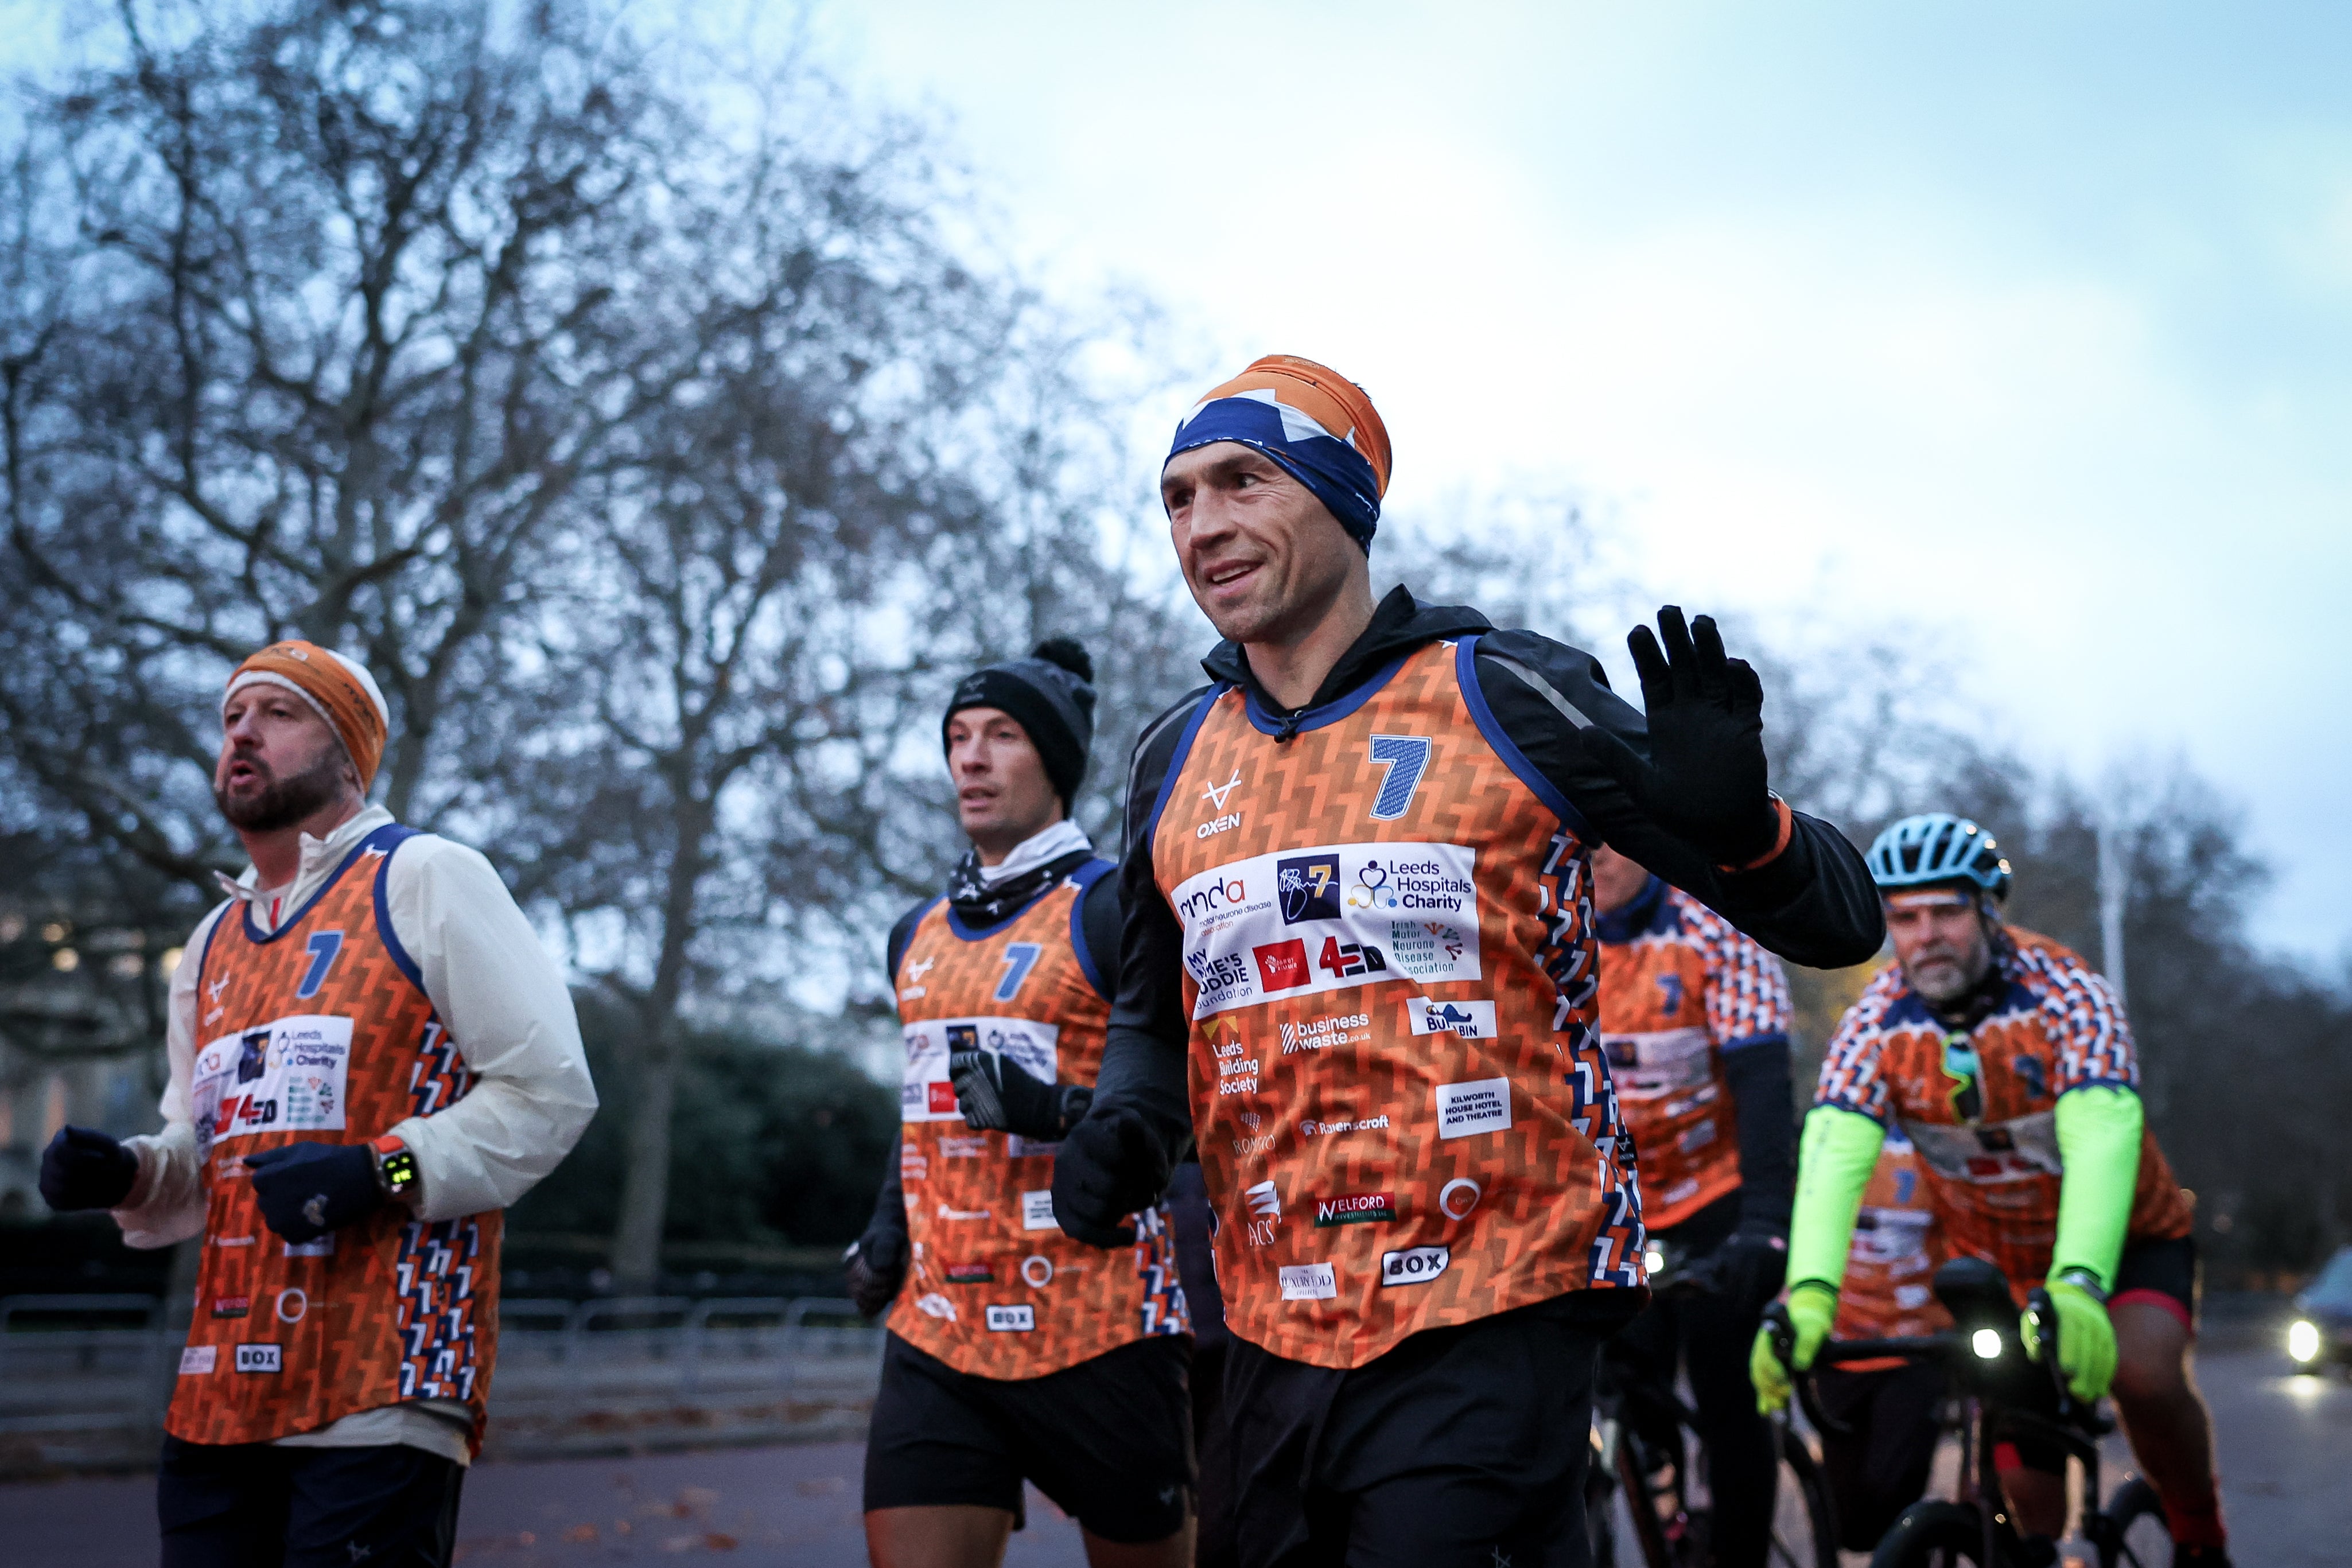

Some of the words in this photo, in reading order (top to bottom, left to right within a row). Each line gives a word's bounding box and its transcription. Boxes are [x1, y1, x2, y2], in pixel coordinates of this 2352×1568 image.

[1369, 734, 1432, 821] 7
[1197, 811, 1241, 838] OXEN
[1390, 860, 1440, 874] Leeds
[1309, 864, 1331, 898] 7
[1397, 877, 1471, 895] Hospitals
[1180, 877, 1246, 918] mnda
[1244, 900, 1272, 913] disease
[1402, 894, 1461, 912] Charity
[1391, 920, 1416, 929] Irish
[1392, 930, 1420, 939] Motor
[1393, 940, 1434, 951] Neurone
[296, 930, 345, 999] 7
[1187, 948, 1207, 968] MY
[1196, 953, 1242, 978] NME'5
[1394, 952, 1434, 963] Disease
[993, 942, 1043, 1003] 7
[1406, 962, 1455, 975] sociation
[1200, 967, 1249, 995] ODDIE
[1196, 986, 1253, 1009] oundation
[1297, 1013, 1370, 1036] business
[1212, 1040, 1244, 1058] Leeds
[1219, 1059, 1258, 1077] Building
[1219, 1077, 1258, 1095] Society
[1451, 1092, 1495, 1104] KILWORTH
[1445, 1104, 1473, 1115] HOUSE
[1475, 1100, 1502, 1110] HOTEL
[1319, 1114, 1389, 1135] Ravenscroft
[1446, 1115, 1464, 1125] AND
[1465, 1109, 1502, 1121] THEATRE
[1319, 1196, 1385, 1222] WELFORD
[1247, 1219, 1274, 1246] ACS
[1389, 1253, 1441, 1275] BOX
[242, 1351, 275, 1364] BOX
